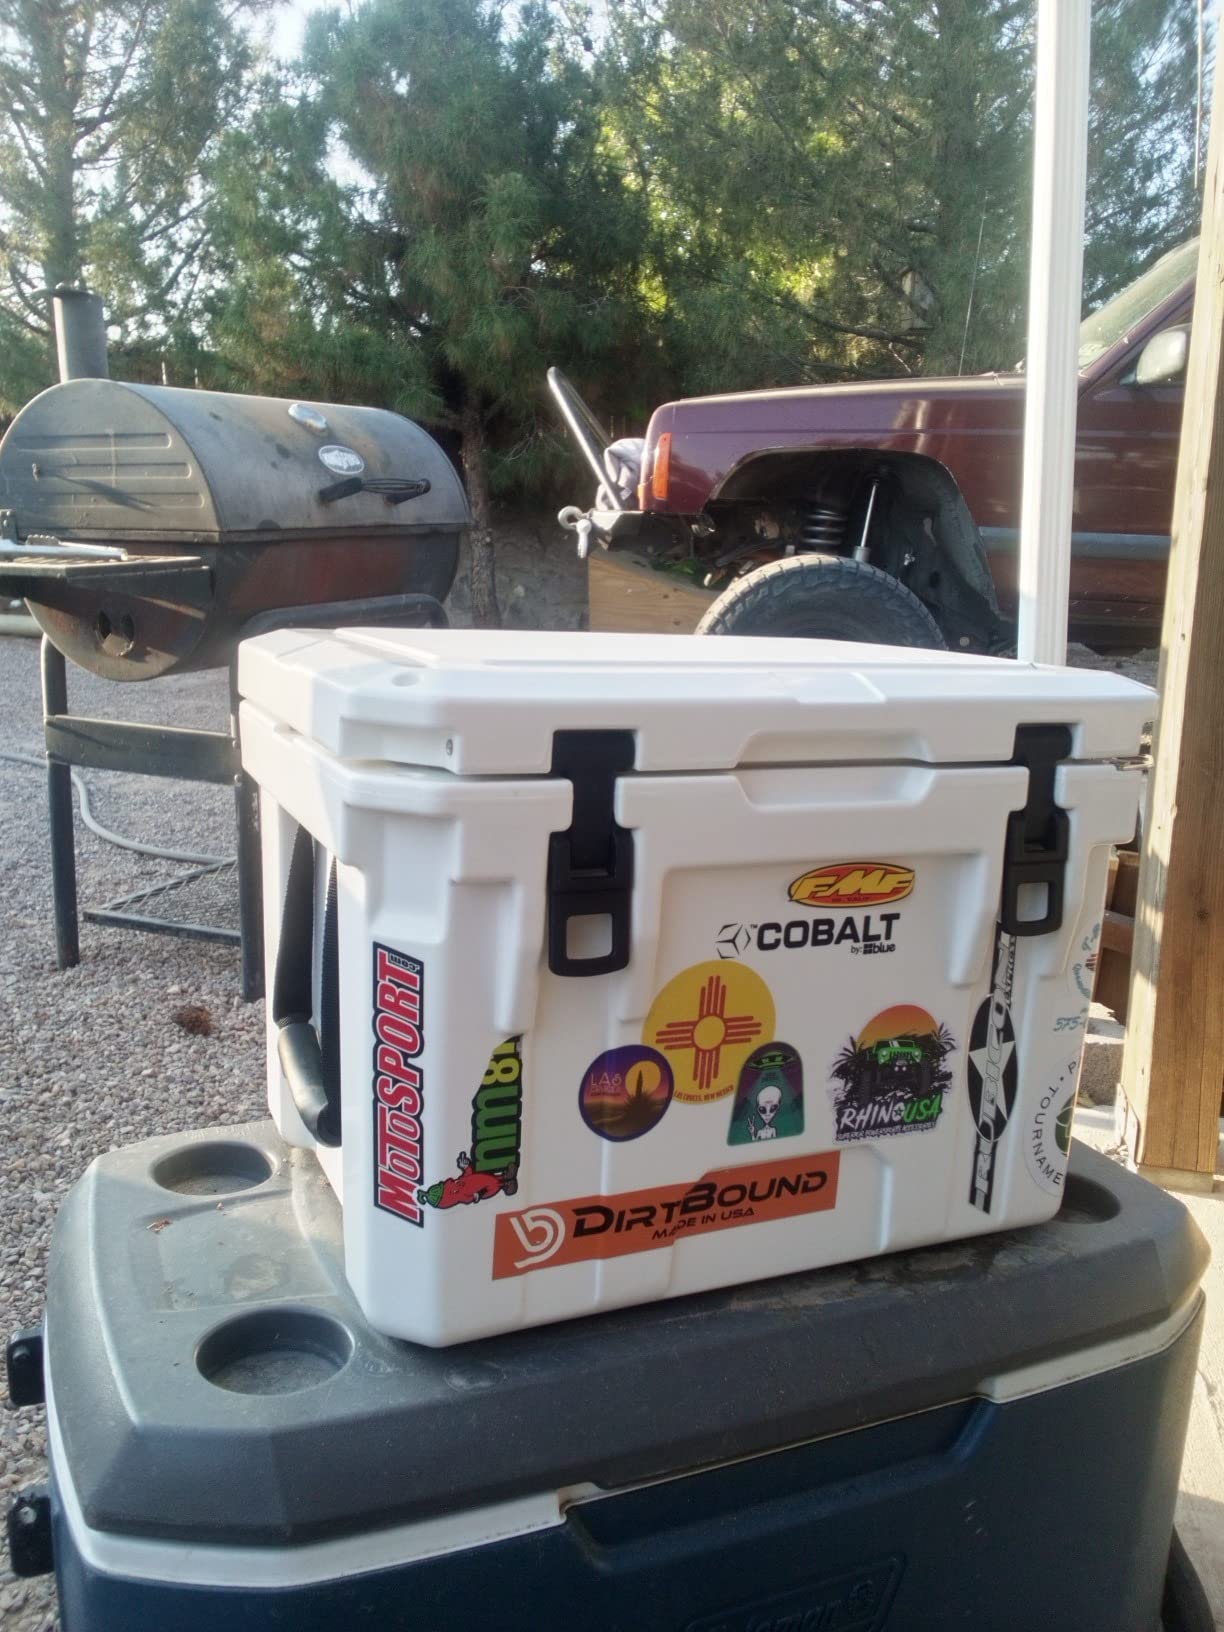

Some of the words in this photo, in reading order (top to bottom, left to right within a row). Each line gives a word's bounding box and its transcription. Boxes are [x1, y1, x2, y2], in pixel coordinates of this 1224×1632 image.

[788, 869, 915, 901] FMF
[757, 912, 900, 951] COBALT
[975, 938, 1010, 1193] RUBICON
[572, 1170, 828, 1238] DIRTBOUND
[652, 1217, 697, 1241] MADE
[702, 1214, 717, 1225] IN
[720, 1207, 755, 1221] USA
